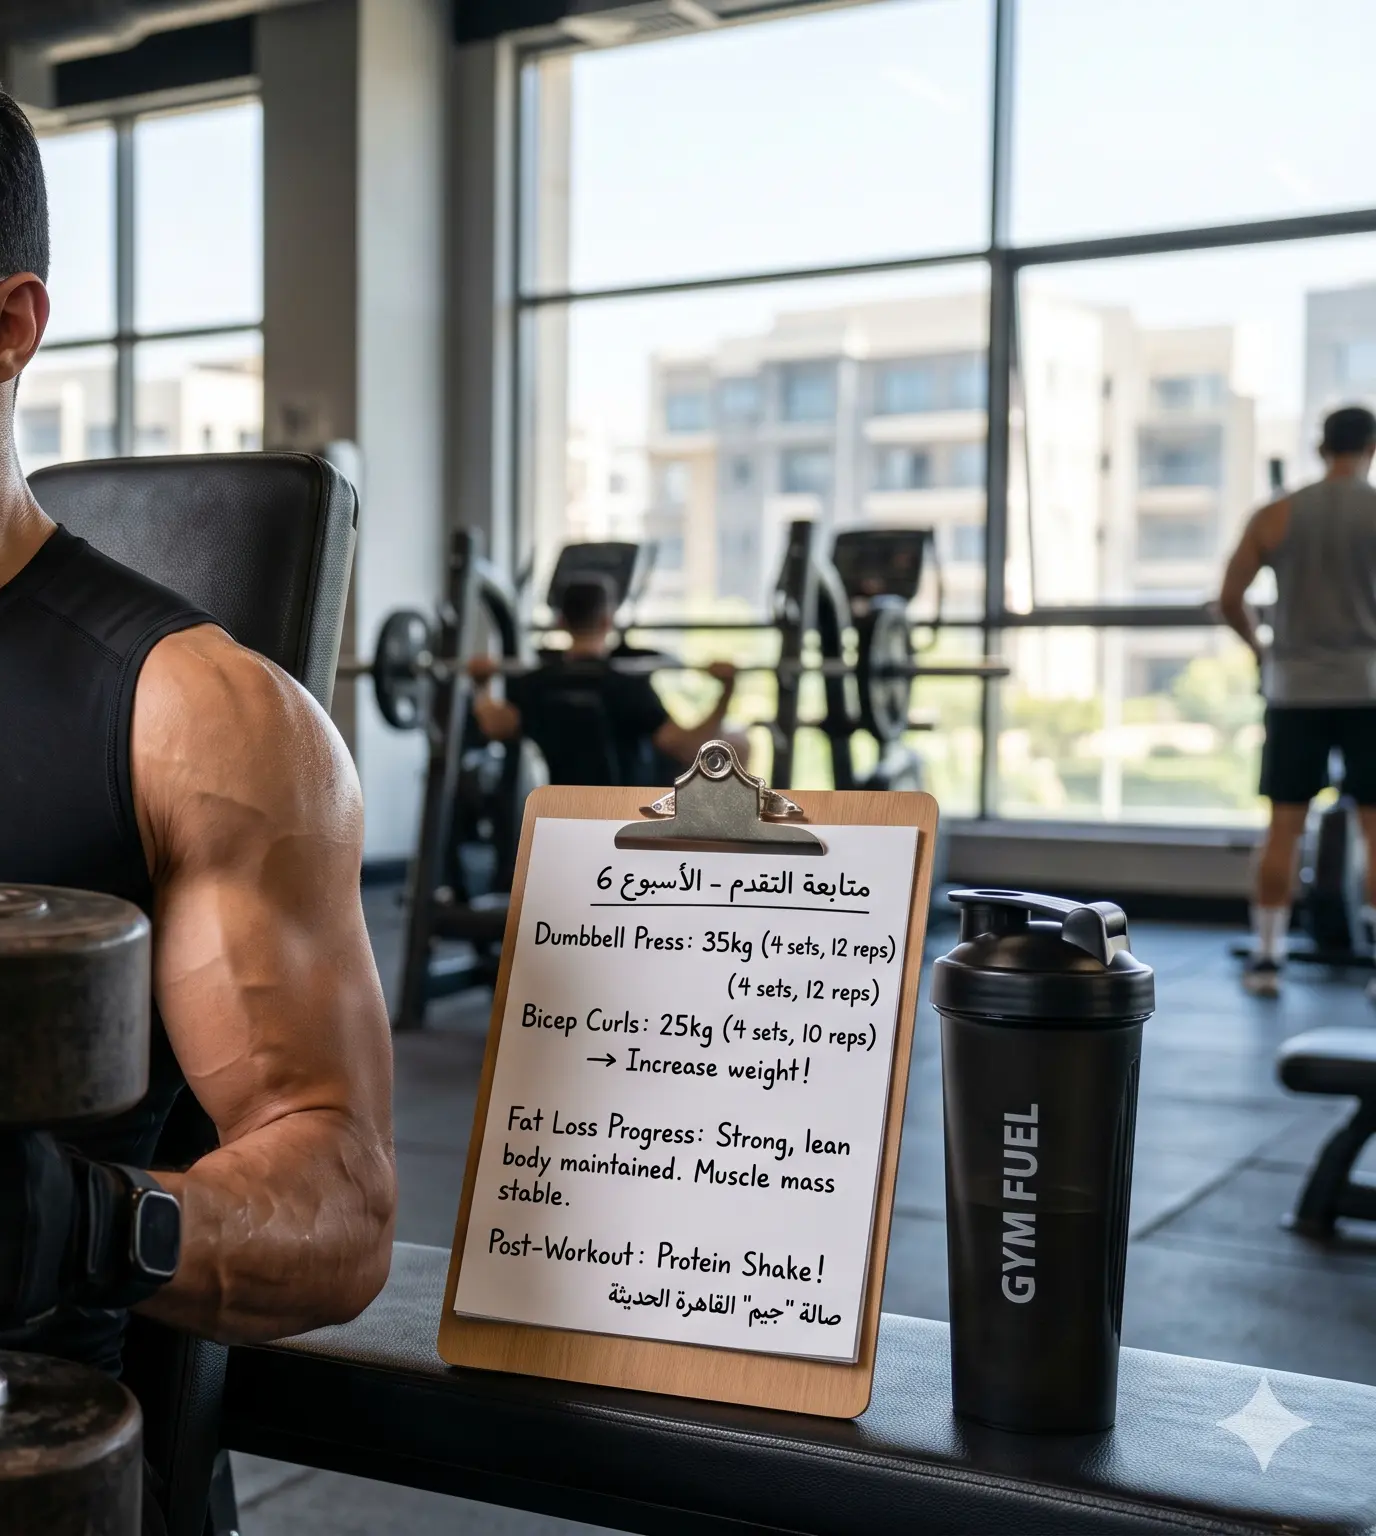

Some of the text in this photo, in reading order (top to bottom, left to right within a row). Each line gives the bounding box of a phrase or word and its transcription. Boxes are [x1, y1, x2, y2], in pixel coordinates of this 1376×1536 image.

[596, 865, 613, 891] 6
[620, 862, 702, 902] الأسبوع
[729, 870, 793, 903] التقدم
[802, 872, 870, 903] متابعة
[534, 920, 896, 965] Dumbbell Press: 35kg (4 sets, 12 reps)
[727, 972, 880, 1008] (4 sets, 12 reps)
[520, 1002, 877, 1053] Bicep Curls: 25kg (4 sets, 10 reps)
[625, 1047, 811, 1091] Increase weight!
[507, 1104, 851, 1162] Fat Loss Progress: Strong, lean
[502, 1141, 835, 1194] body maintained. Muscle mass
[497, 1177, 570, 1207] stable.
[1001, 1103, 1039, 1304] GYM FUEL
[488, 1227, 825, 1284] Post-Workout: Protein Shake!
[608, 1282, 842, 1328] صالة "جيم" القاهرة الحديثة
